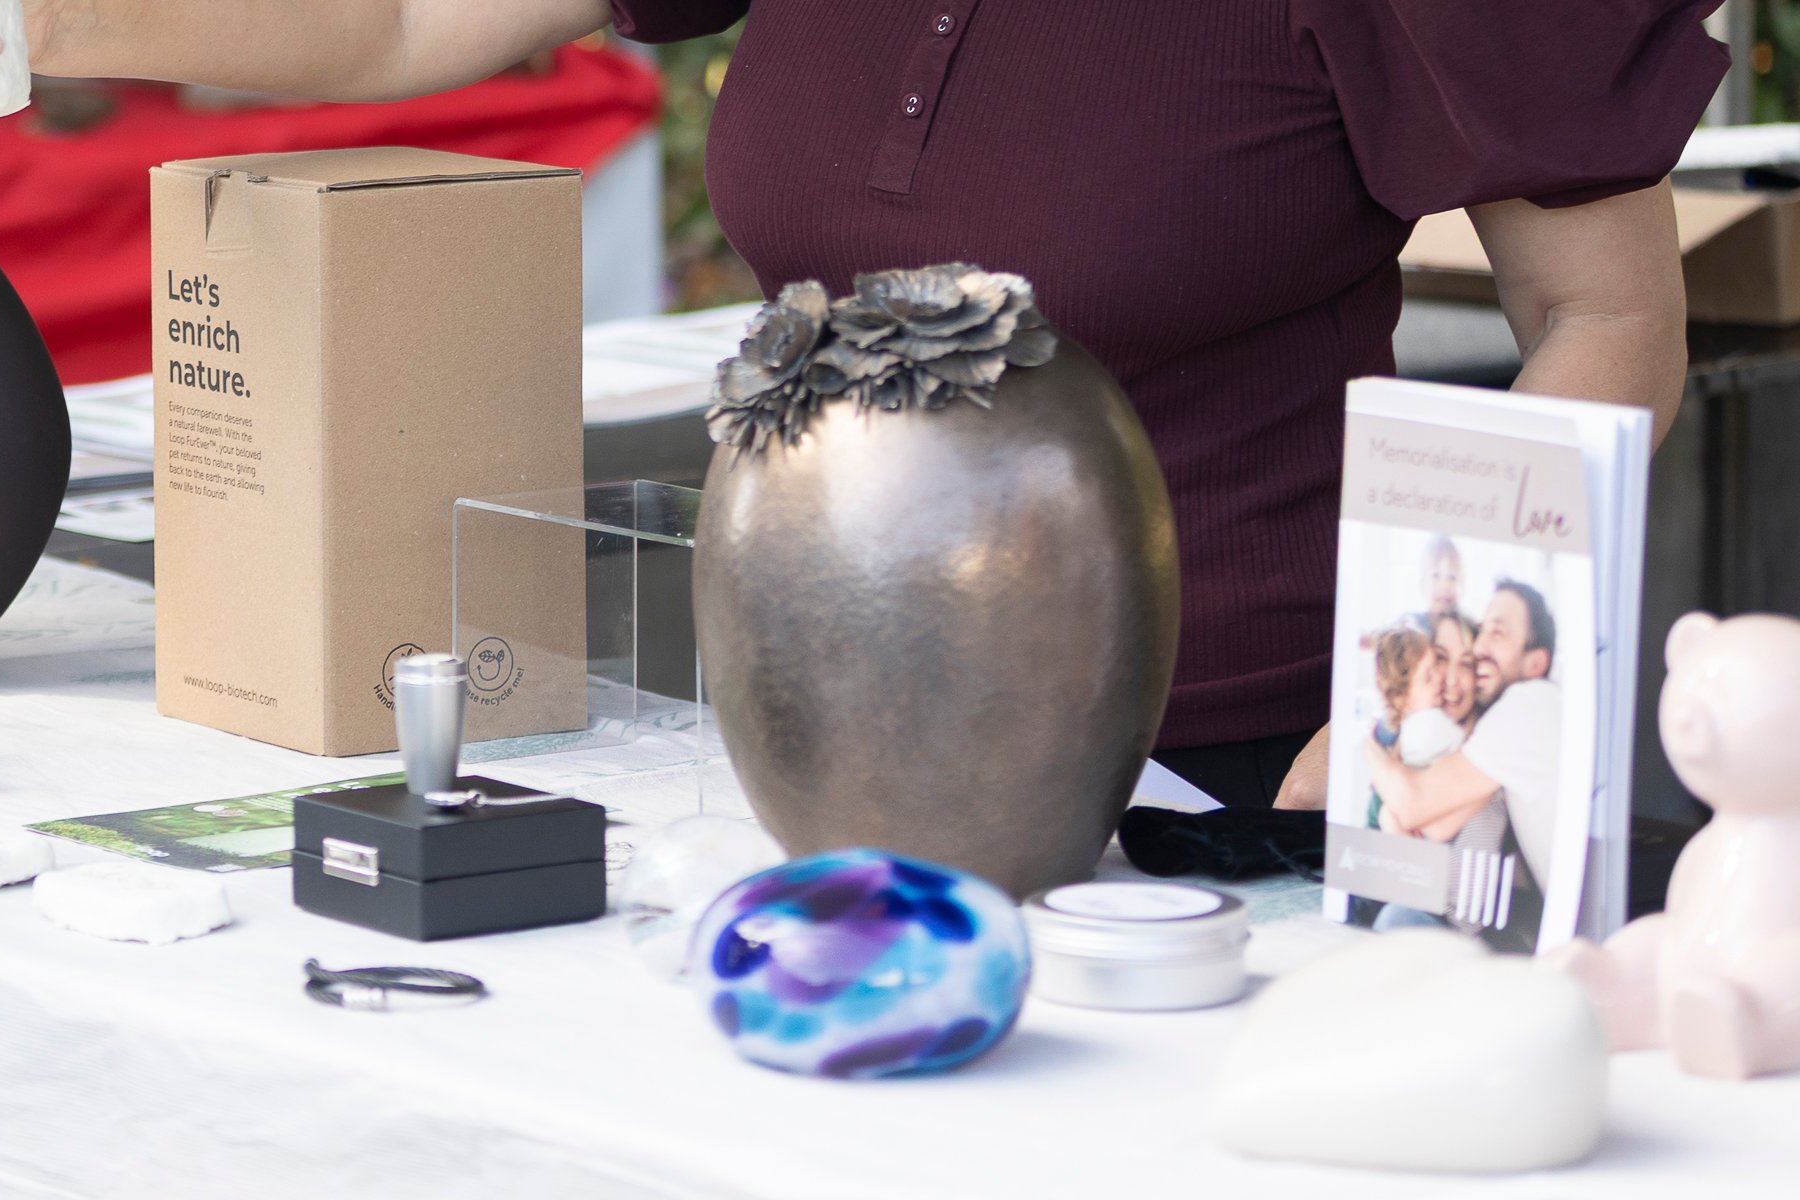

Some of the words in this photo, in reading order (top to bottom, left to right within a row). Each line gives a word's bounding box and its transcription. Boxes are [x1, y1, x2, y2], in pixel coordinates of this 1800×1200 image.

[168, 269, 220, 308] Let's
[168, 314, 240, 354] enrich
[169, 359, 251, 399] nature.
[169, 400, 186, 416] Every
[186, 407, 223, 421] companion
[224, 413, 253, 427] deserves
[174, 418, 196, 432] natural
[196, 421, 223, 437] farewell.
[224, 427, 241, 441] With
[241, 430, 253, 444] the
[168, 431, 186, 447] Loop
[219, 444, 235, 457] your
[235, 445, 262, 461] beloved
[1368, 436, 1499, 479] Memorialisation
[169, 450, 179, 460] pet
[180, 451, 204, 465] returns
[204, 455, 212, 467] to
[212, 457, 235, 473] nature,
[235, 462, 257, 479] giving
[169, 463, 184, 474] back
[185, 466, 193, 478] to
[193, 467, 205, 480] the
[205, 471, 223, 485] earth
[223, 476, 236, 488] and
[237, 478, 265, 495] allowing
[169, 481, 183, 490] new
[183, 481, 194, 494] life
[194, 484, 203, 496] to
[1380, 480, 1475, 520] declaration
[1479, 495, 1500, 522] of
[183, 674, 278, 709] www.loop-biotech.com
[480, 686, 513, 707] recycle
[512, 667, 525, 689] me!
